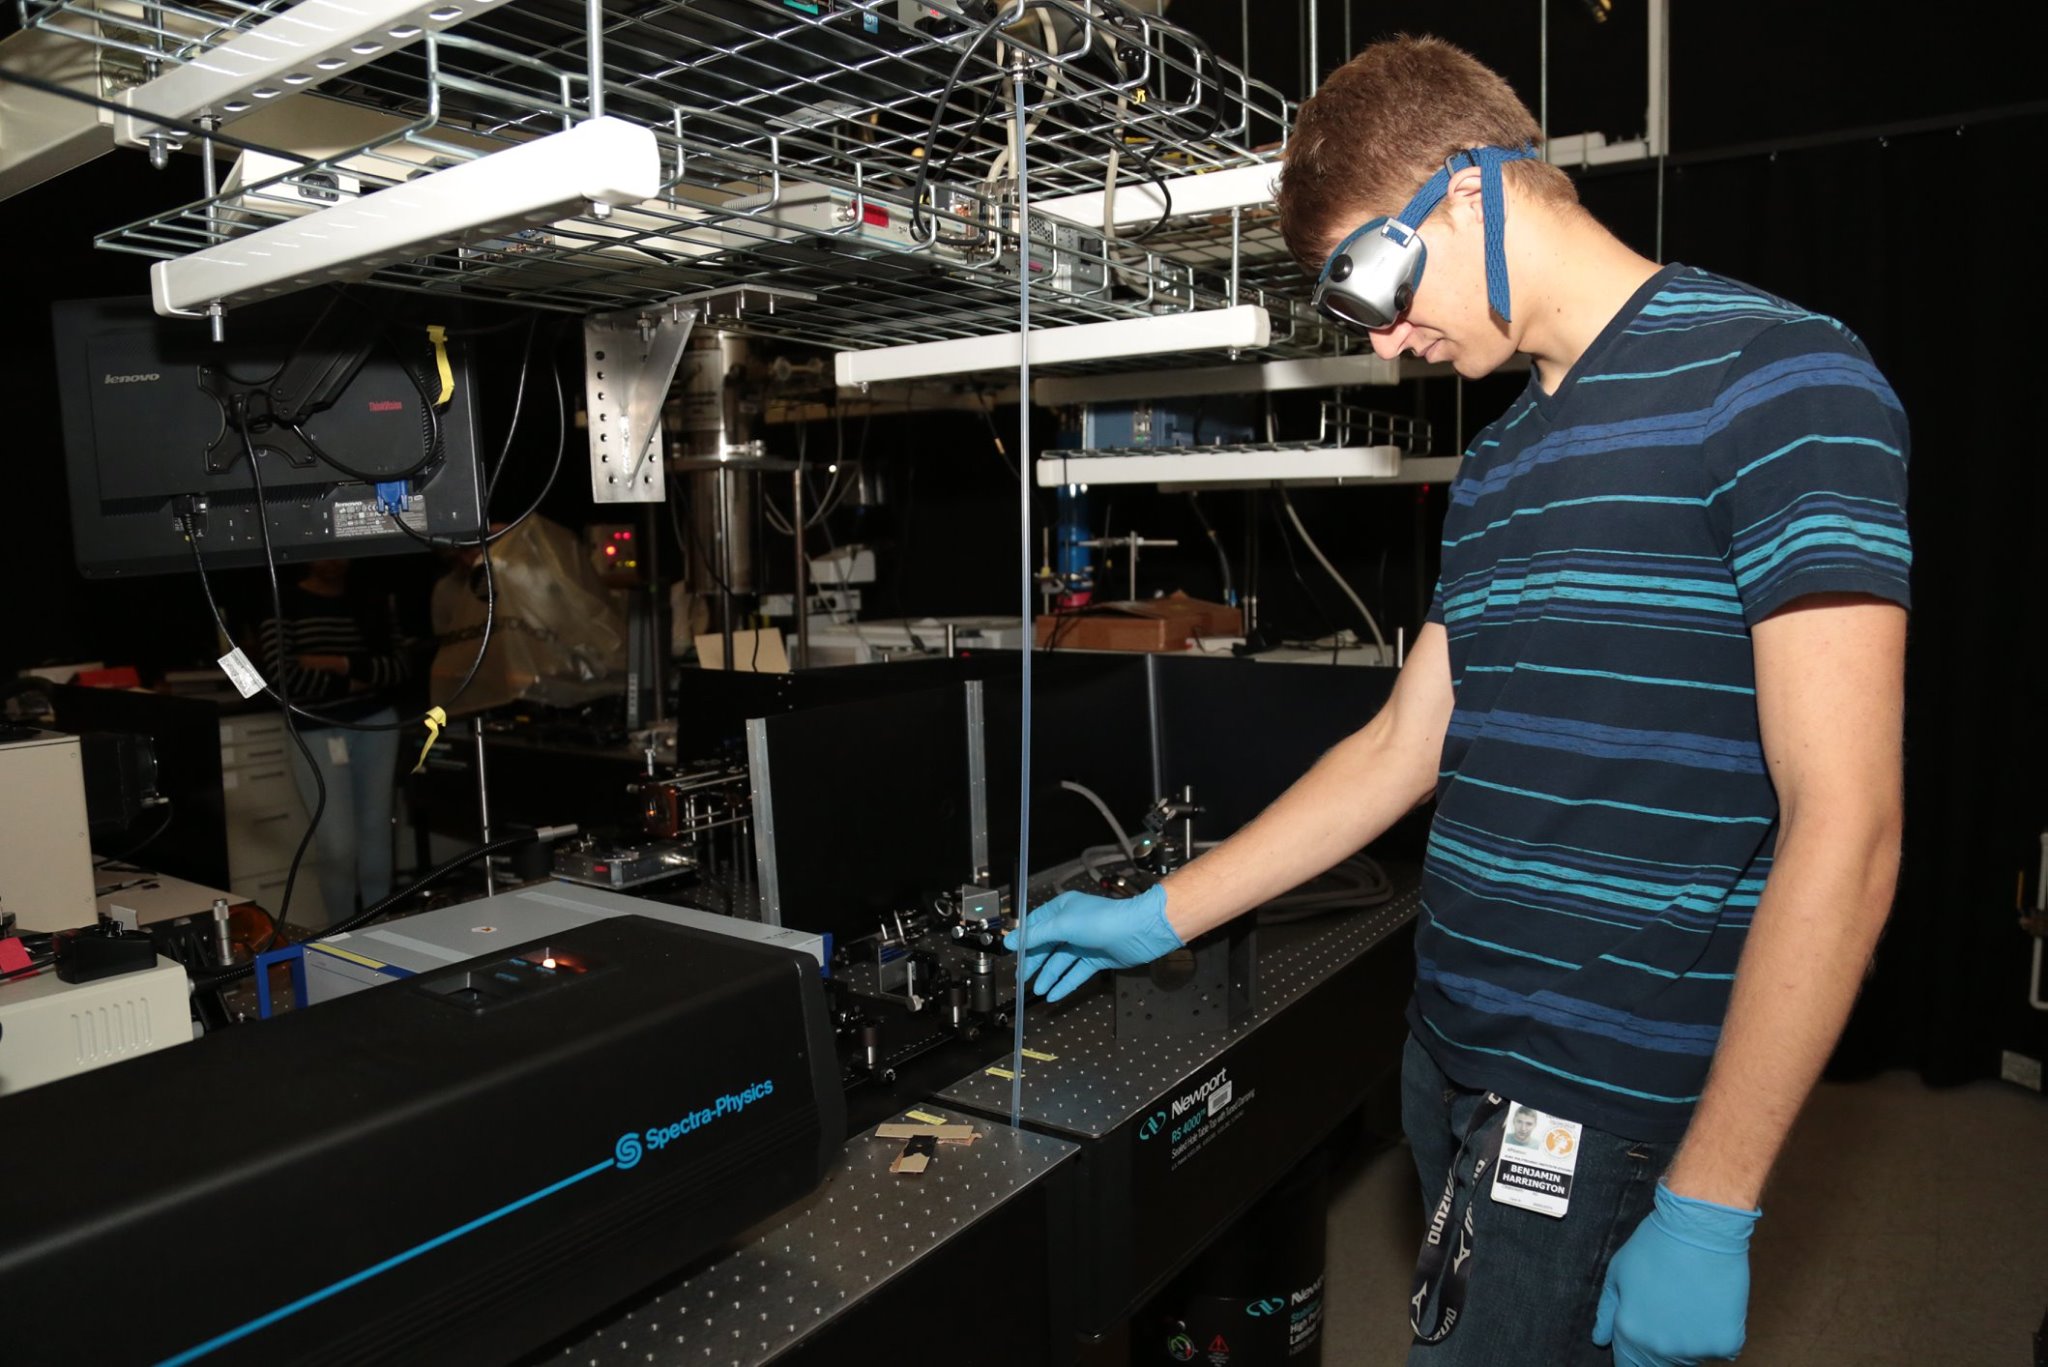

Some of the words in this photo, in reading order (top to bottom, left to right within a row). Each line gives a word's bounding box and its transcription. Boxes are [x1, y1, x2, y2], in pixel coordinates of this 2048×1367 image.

[104, 373, 160, 385] lenovo
[1171, 1067, 1227, 1120] Newport
[645, 1079, 774, 1150] Spectra-Physics
[1171, 1126, 1182, 1144] RS
[1510, 1164, 1561, 1183] BENJAMIN
[1502, 1173, 1566, 1195] HARRINGTON
